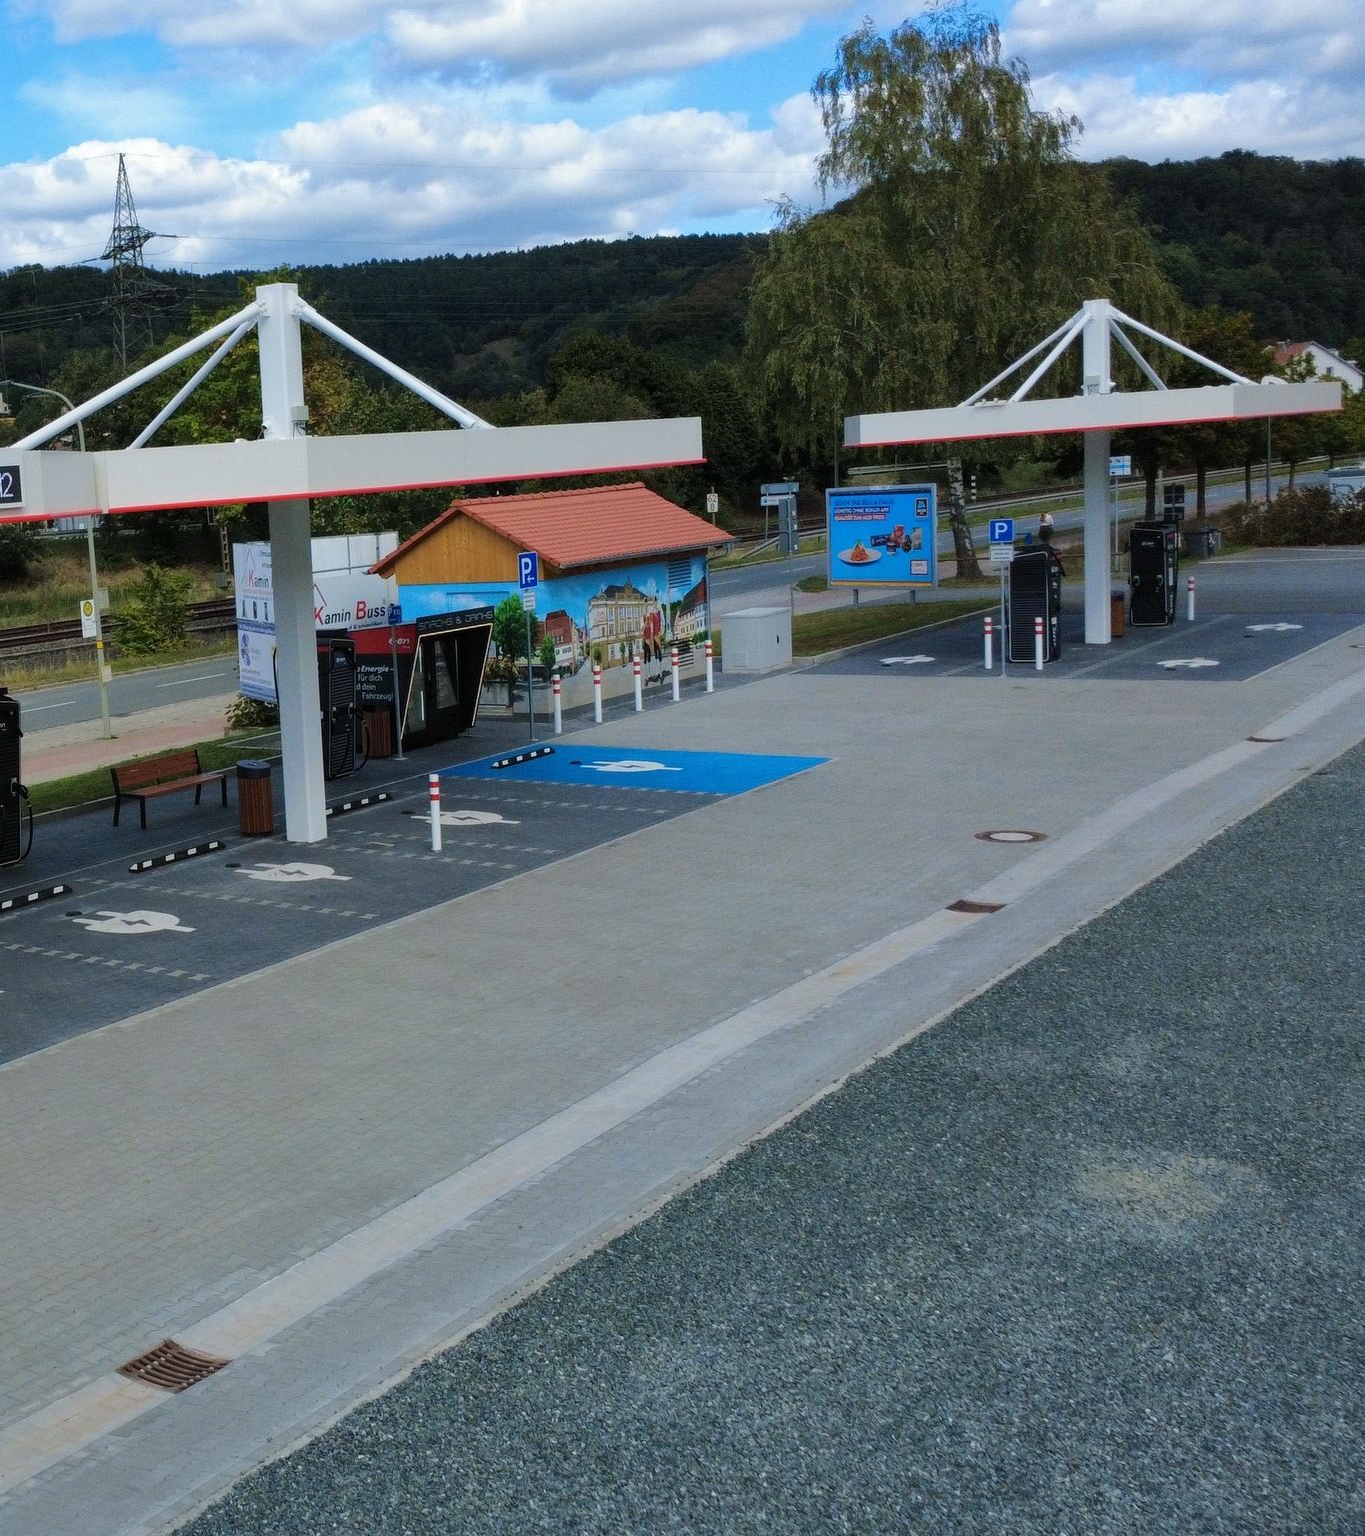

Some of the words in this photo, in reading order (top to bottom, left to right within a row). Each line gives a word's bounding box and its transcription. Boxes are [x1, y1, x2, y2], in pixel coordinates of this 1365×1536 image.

[995, 522, 1008, 539] P
[521, 557, 532, 585] P
[314, 605, 351, 625] Kamin
[356, 600, 387, 620] Buss
[361, 664, 389, 673] Energie
[369, 674, 383, 682] dich
[362, 683, 376, 691] dein
